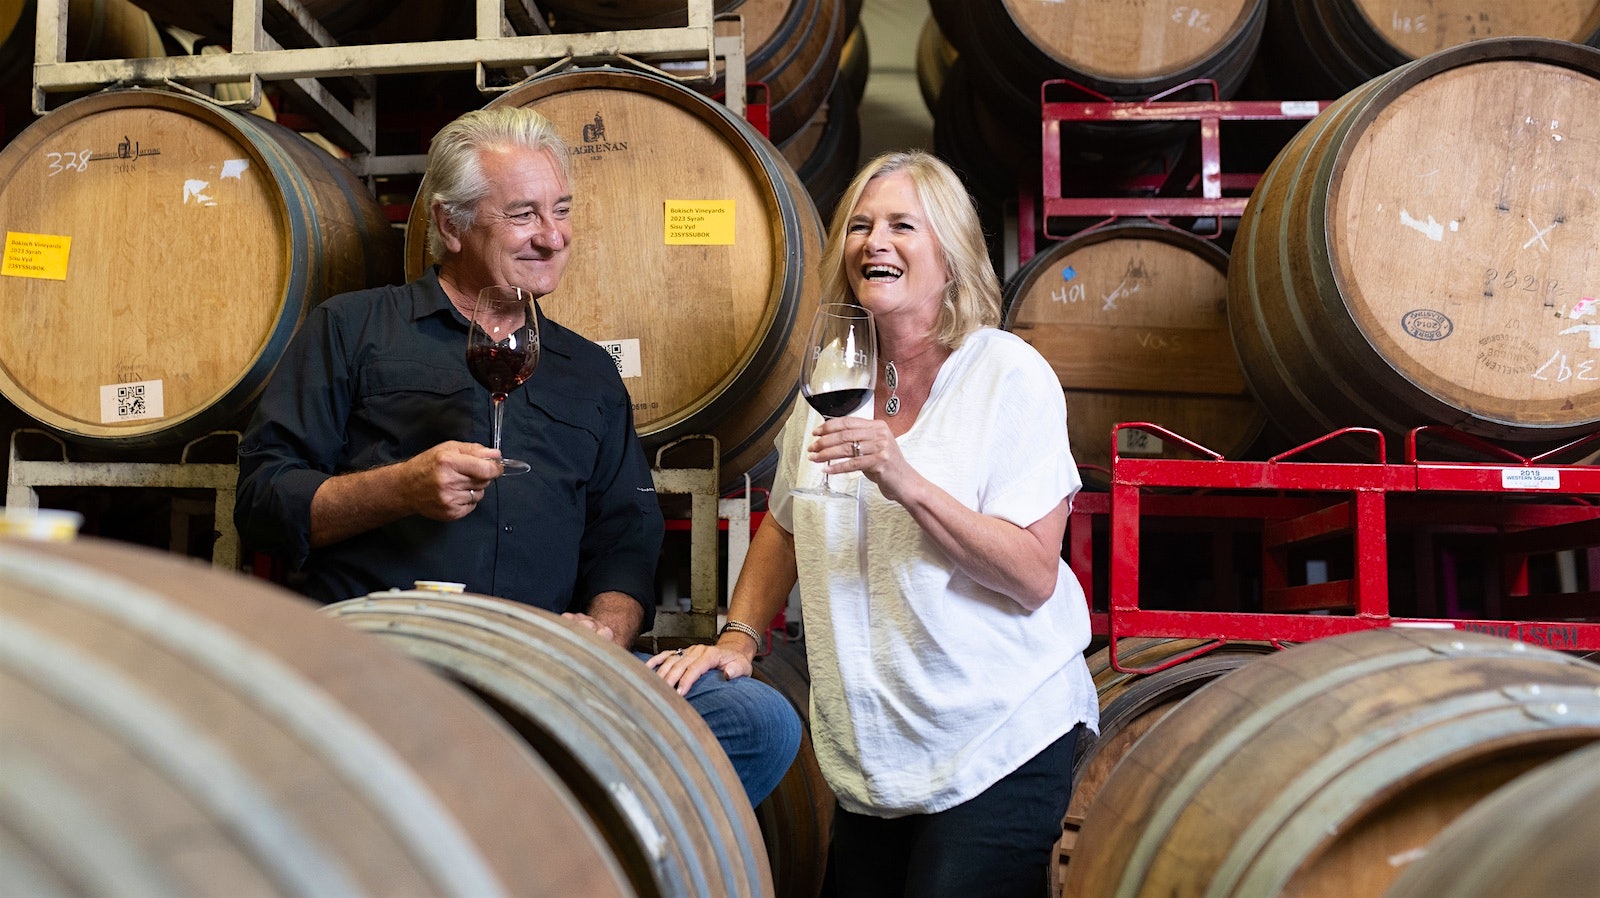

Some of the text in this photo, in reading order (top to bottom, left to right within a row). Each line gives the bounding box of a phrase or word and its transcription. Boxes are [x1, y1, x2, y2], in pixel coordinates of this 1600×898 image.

[47, 148, 93, 177] 328
[114, 163, 136, 174] 2018
[1051, 283, 1086, 304] 401
[1531, 350, 1599, 382] 397
